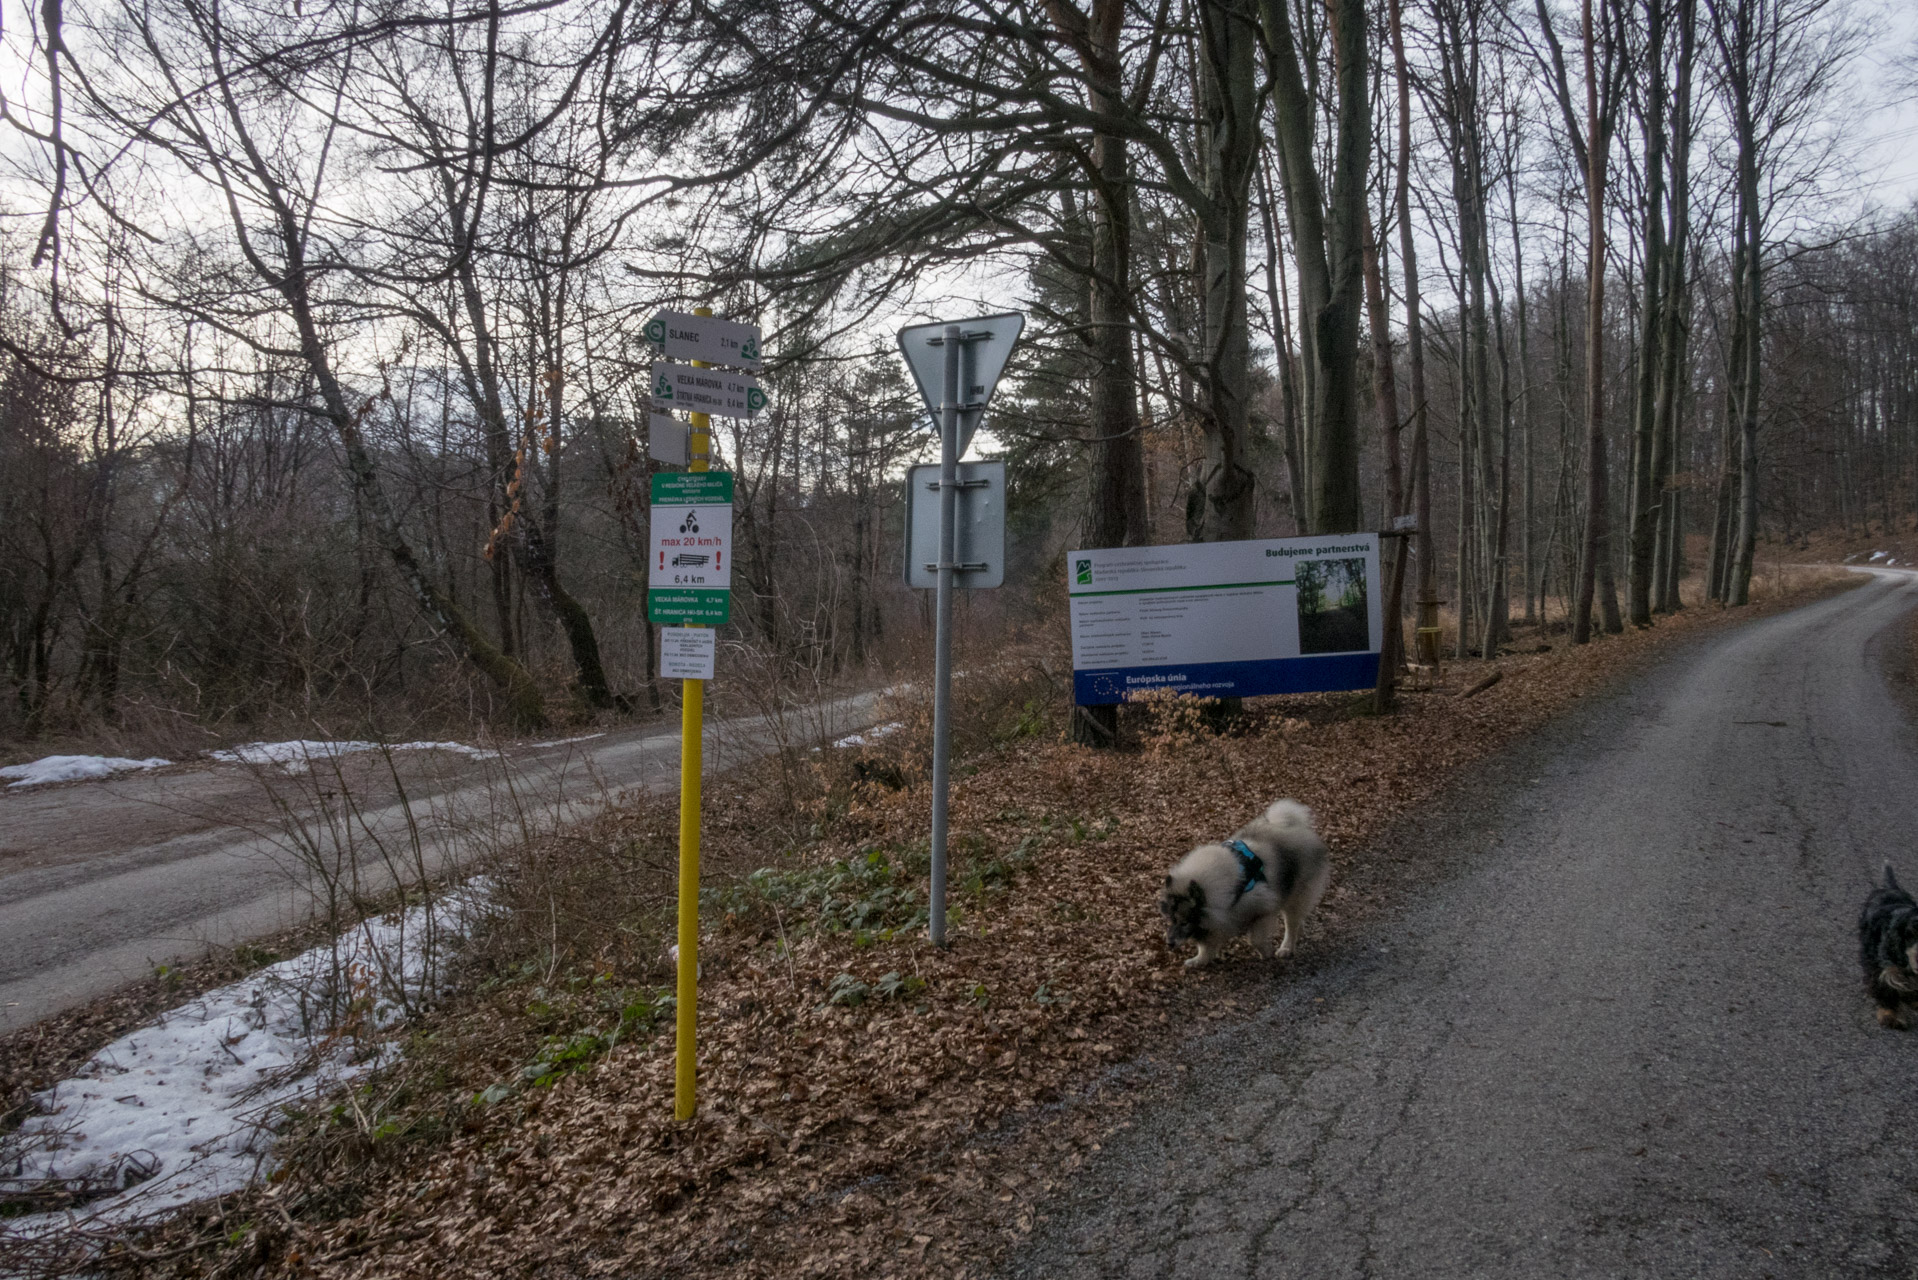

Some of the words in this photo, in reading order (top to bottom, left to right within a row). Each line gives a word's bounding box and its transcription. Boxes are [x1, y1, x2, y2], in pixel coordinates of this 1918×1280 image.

[669, 328, 700, 343] SLANEC
[721, 337, 729, 349] 2,1
[731, 339, 738, 348] km
[728, 382, 736, 393] 4,7
[737, 384, 744, 393] km
[736, 400, 744, 409] km
[683, 537, 695, 546] 20
[698, 536, 722, 546] km/h
[1266, 546, 1313, 558] Budujeme
[1316, 543, 1370, 556] partnerstvá
[675, 575, 688, 585] 6,4
[691, 574, 704, 584] km
[1126, 674, 1166, 685] Európska
[1167, 673, 1187, 681] únia
[1212, 681, 1235, 689] rozvoja
